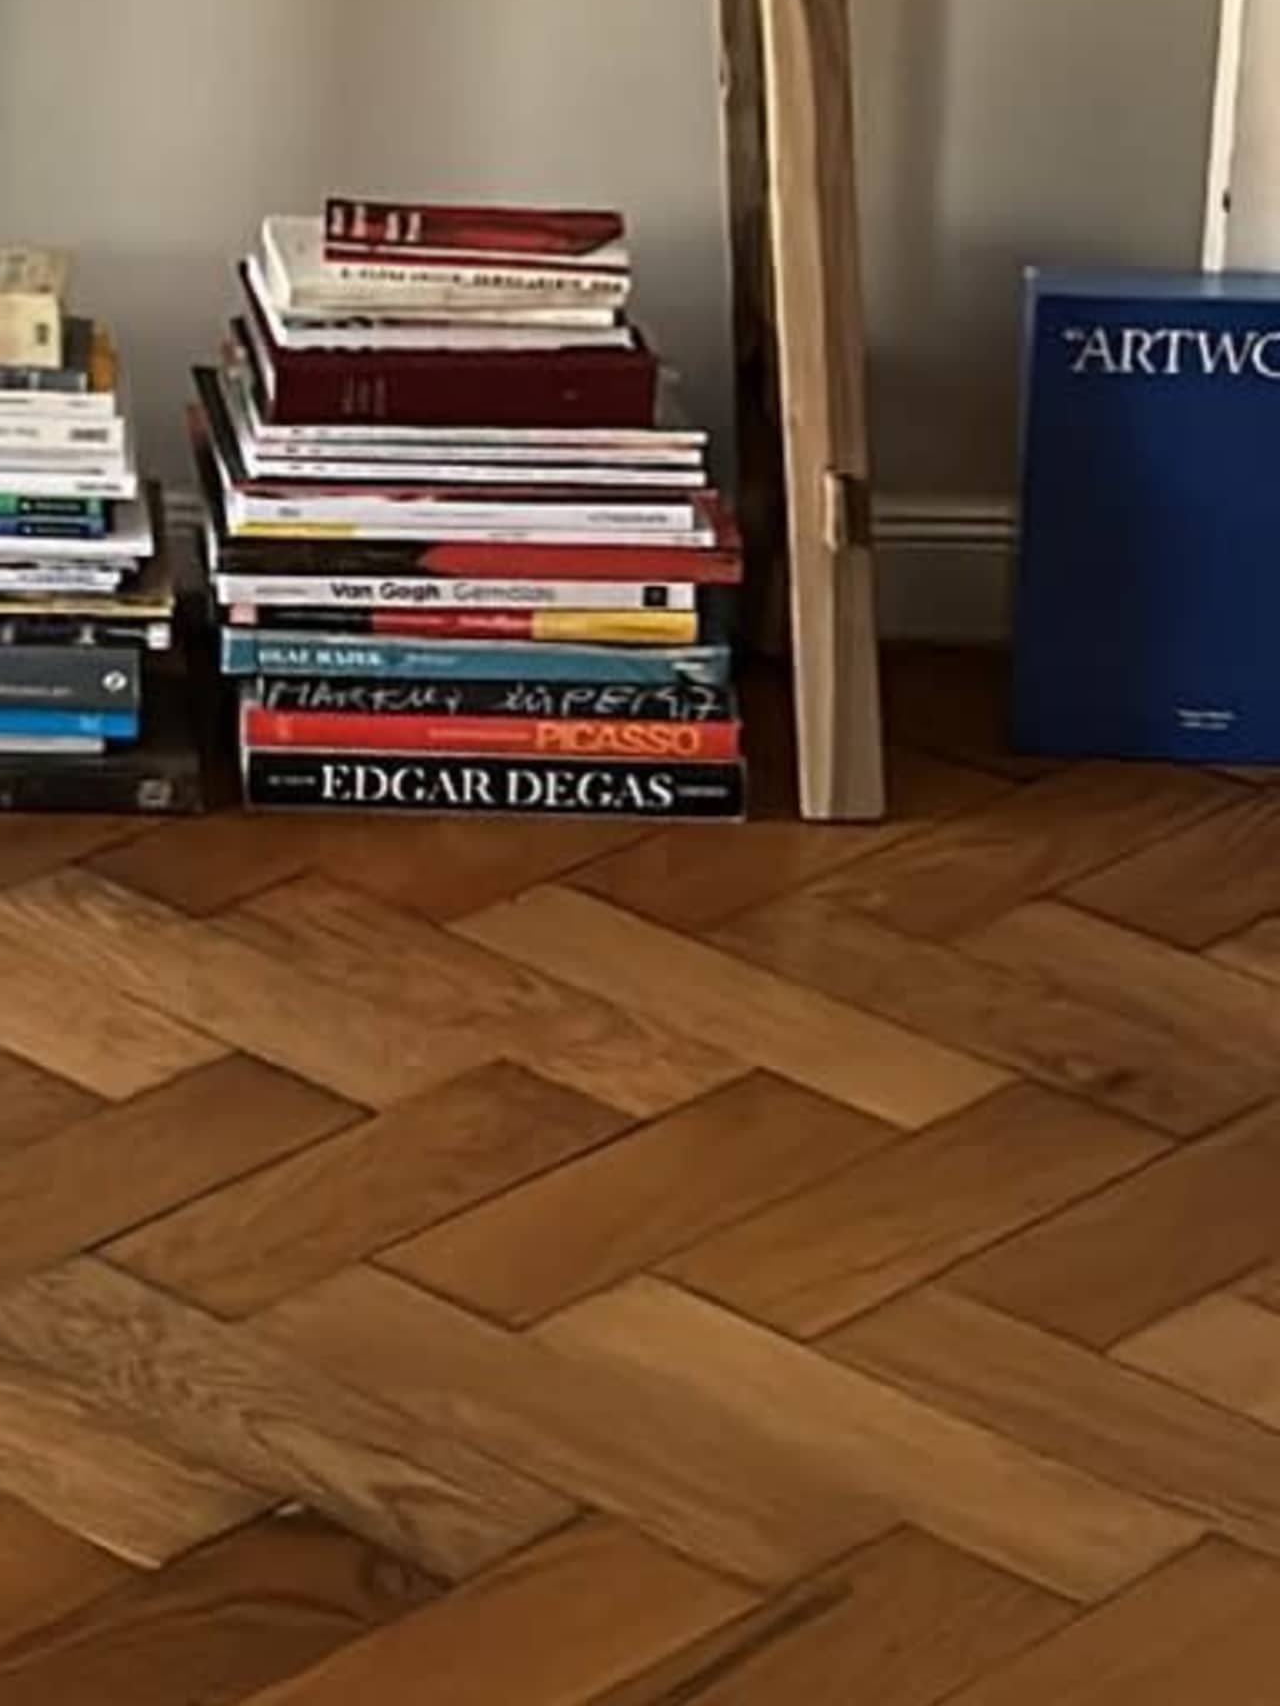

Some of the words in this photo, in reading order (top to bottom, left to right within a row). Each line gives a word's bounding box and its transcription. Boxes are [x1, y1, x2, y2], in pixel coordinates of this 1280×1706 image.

[330, 582, 372, 598] Van
[379, 582, 440, 602] Gogh
[535, 722, 702, 754] PICASSO
[321, 764, 496, 804] EDGAR
[506, 769, 676, 809] DEGAS
